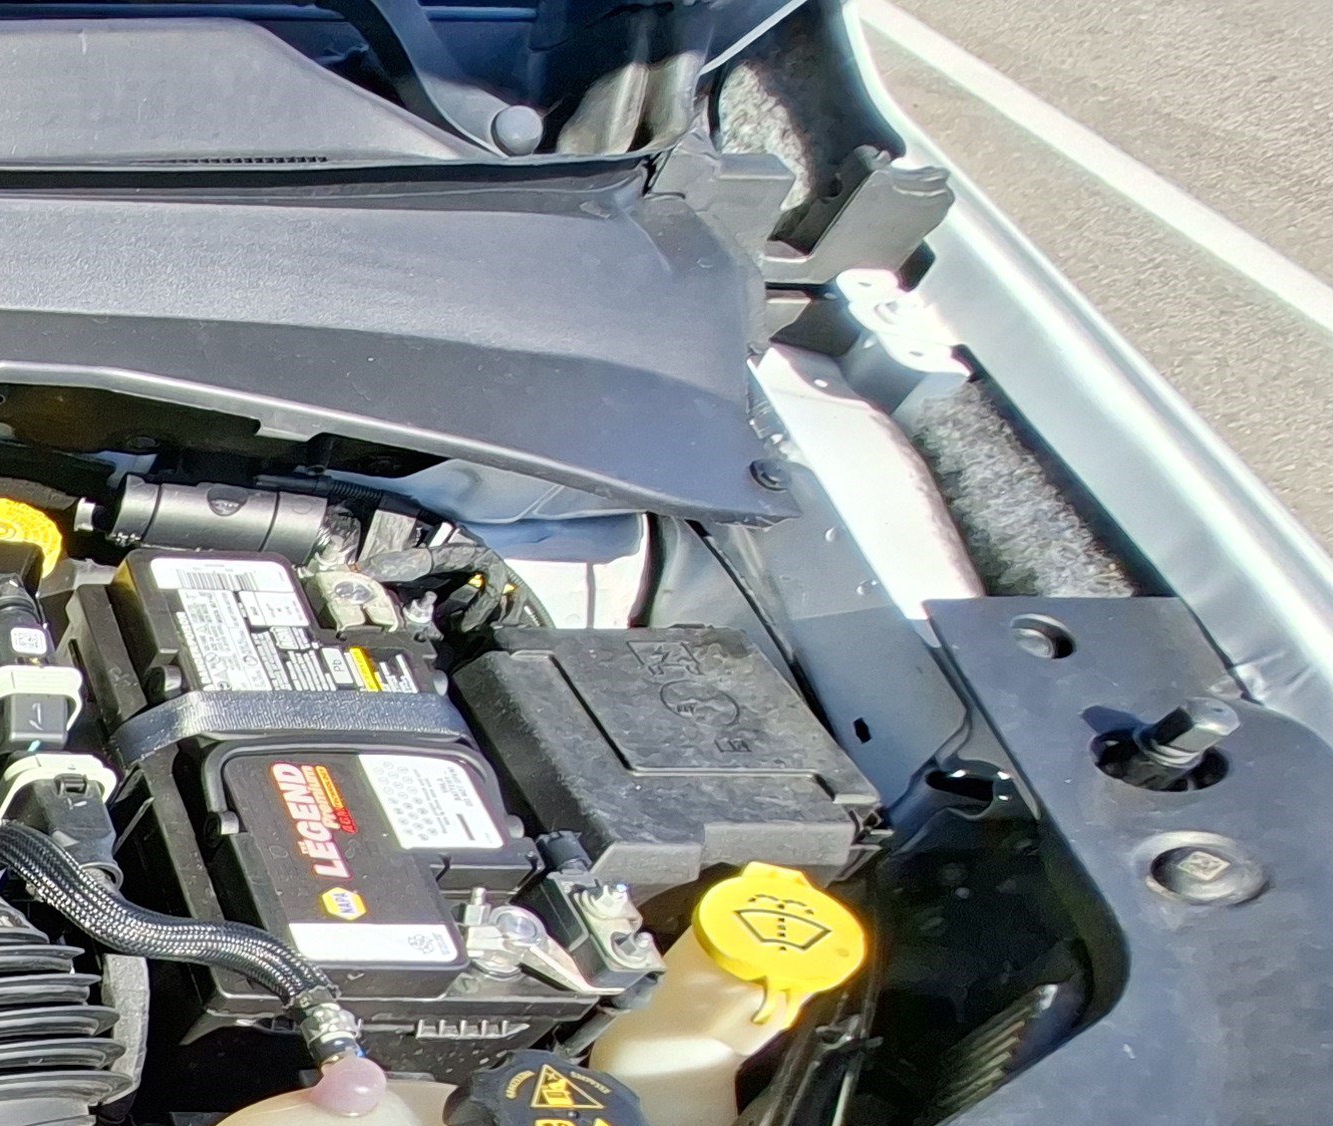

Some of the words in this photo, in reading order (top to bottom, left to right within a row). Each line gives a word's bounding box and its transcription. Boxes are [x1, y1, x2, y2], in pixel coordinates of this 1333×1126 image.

[332, 659, 346, 672] Pb
[272, 763, 350, 878] LEGEND
[301, 765, 341, 830] Premium
